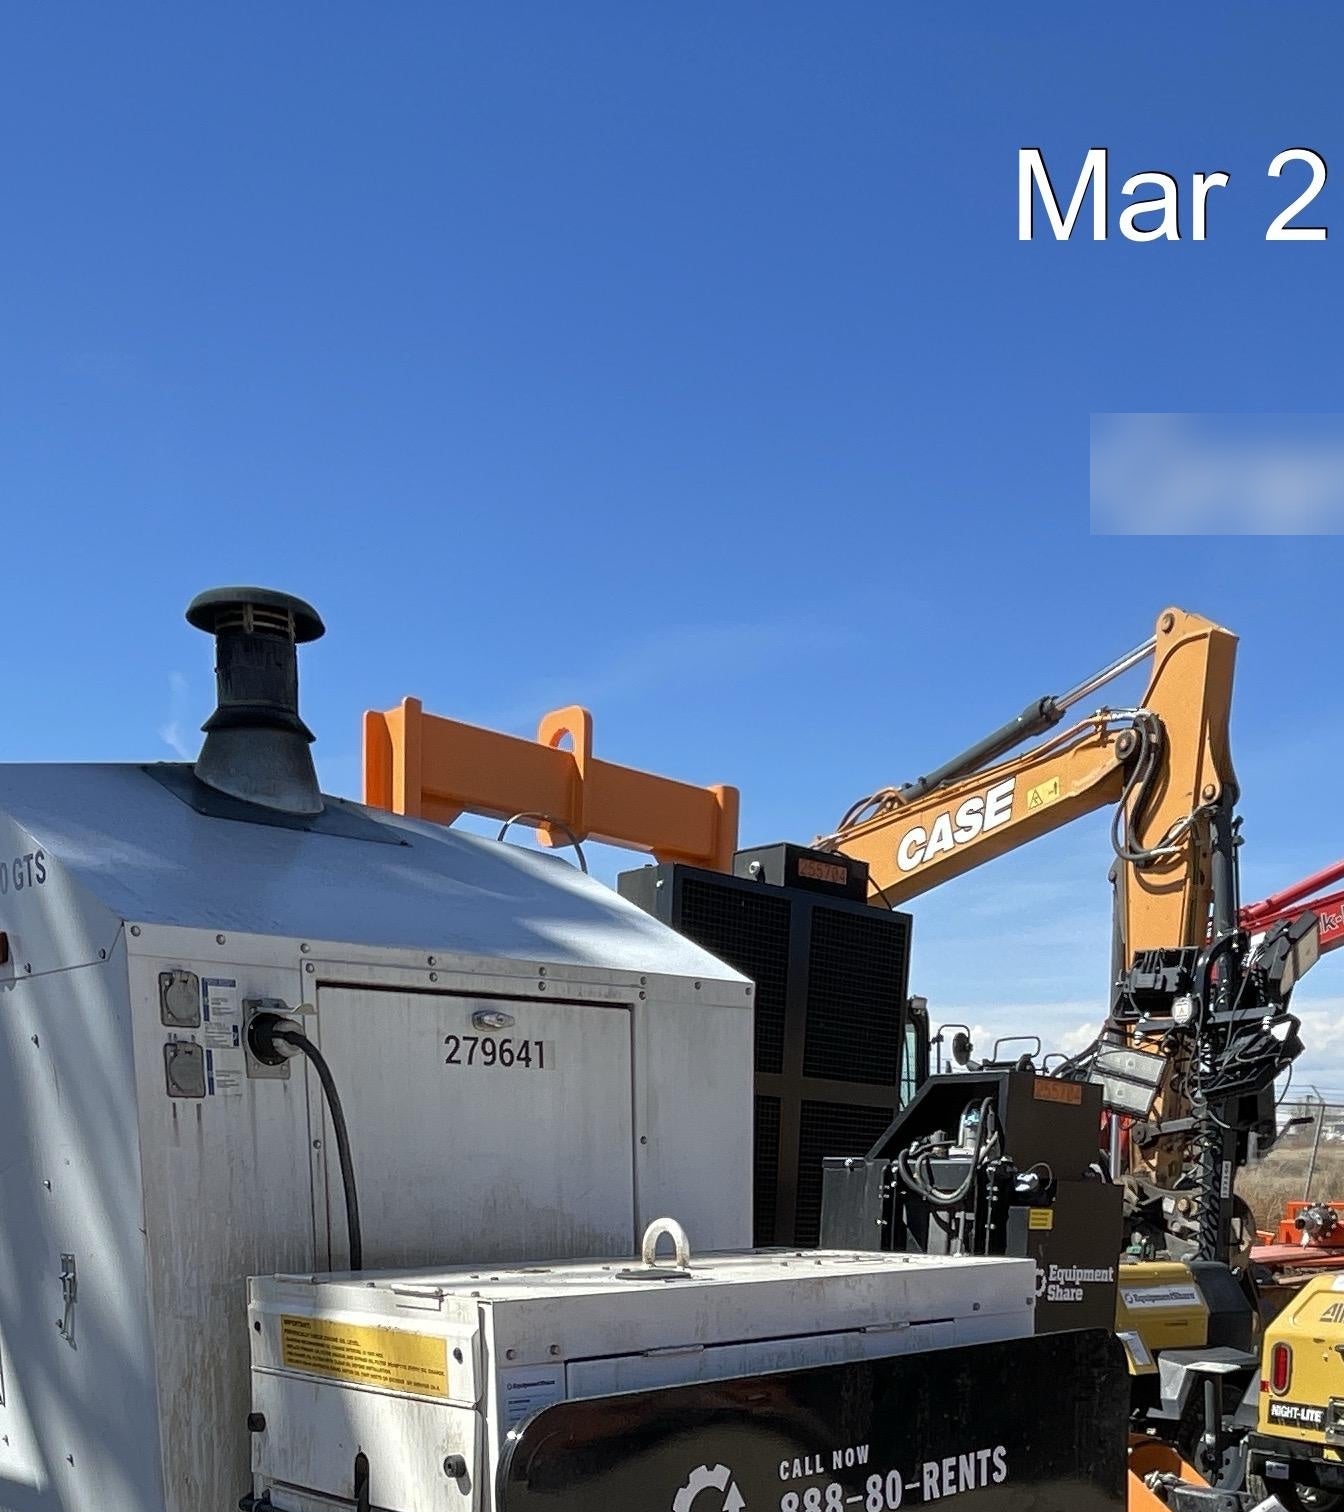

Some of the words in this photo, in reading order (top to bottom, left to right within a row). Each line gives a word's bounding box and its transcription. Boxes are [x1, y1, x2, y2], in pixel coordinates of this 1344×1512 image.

[896, 774, 1017, 872] CASE
[12, 849, 48, 892] GTS
[444, 1034, 544, 1069] 279641
[1047, 1264, 1114, 1286] Equipment
[1047, 1285, 1084, 1302] Share
[1271, 1403, 1322, 1422] NIGHT-LITE
[779, 1453, 824, 1481] CALL
[832, 1444, 870, 1470] NOW
